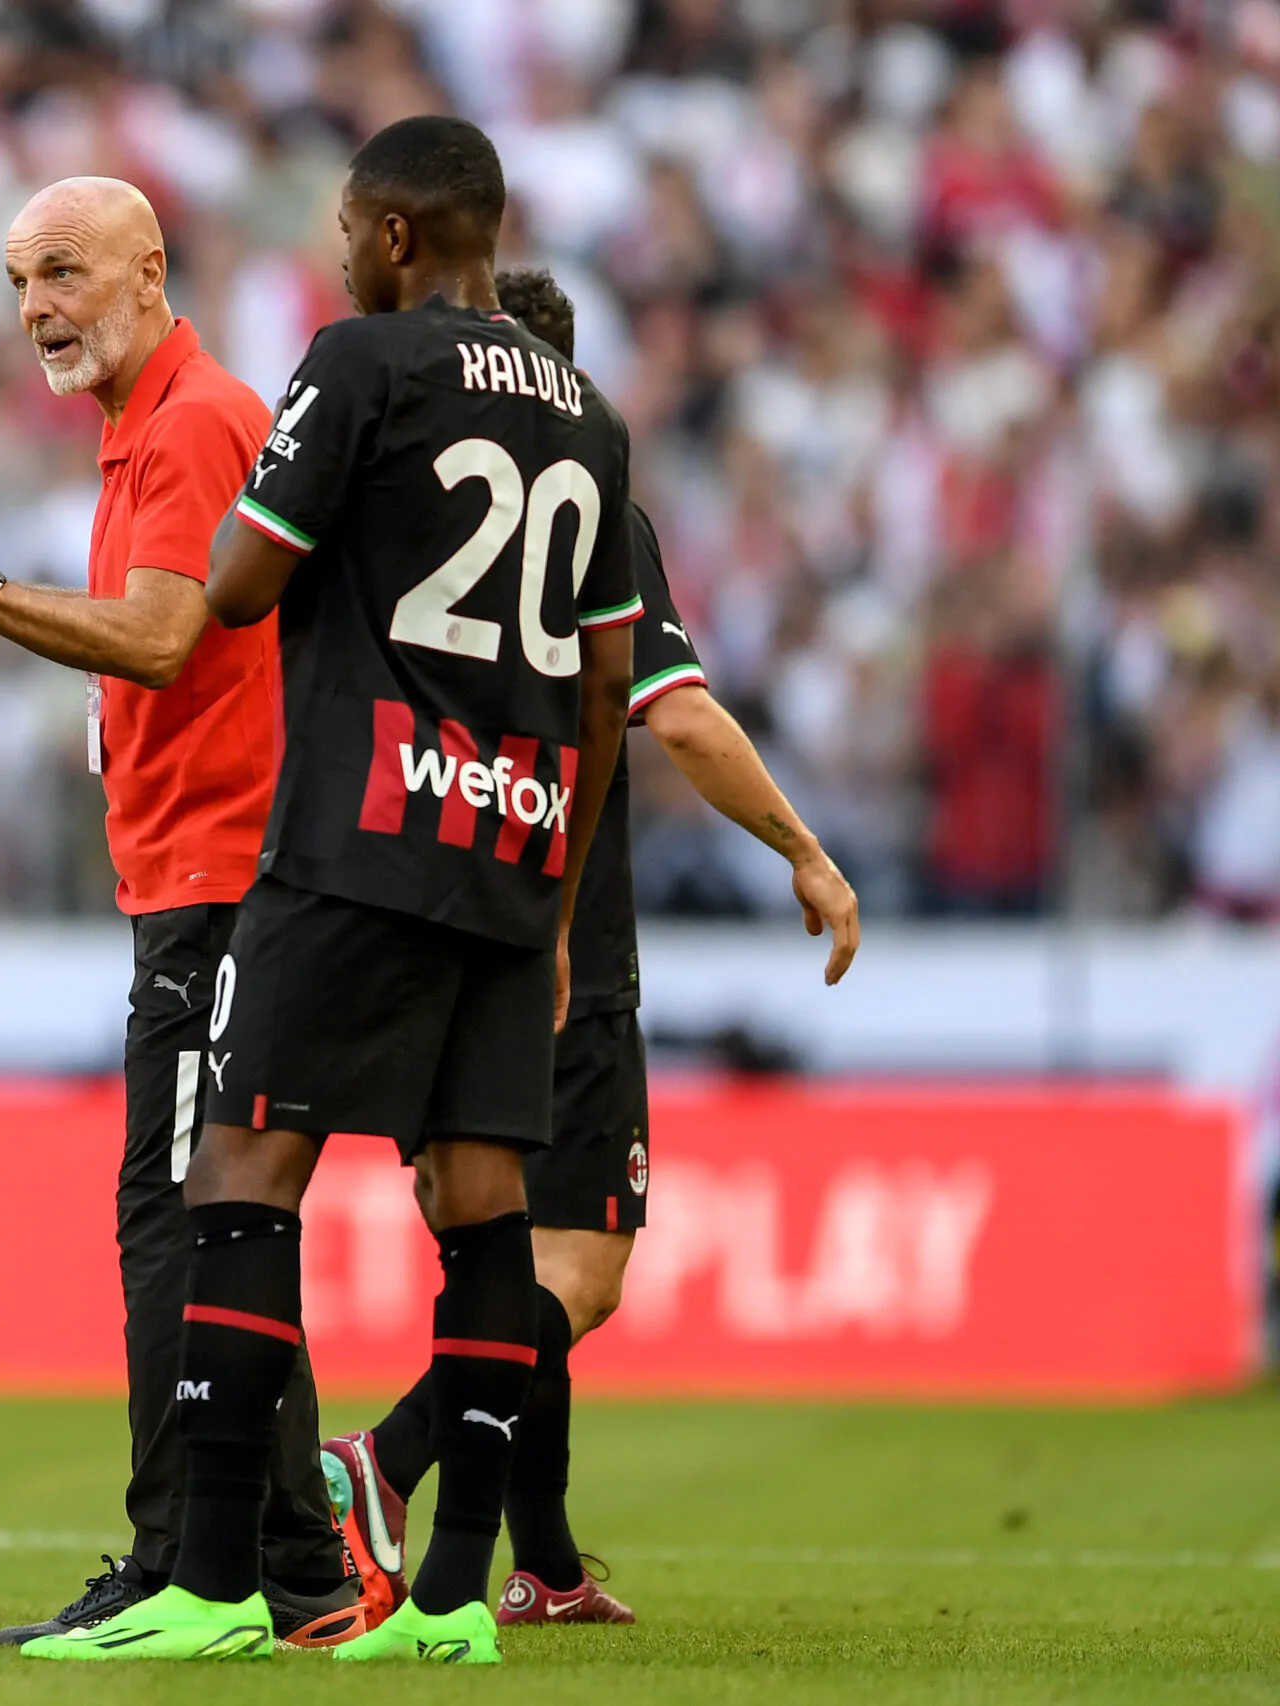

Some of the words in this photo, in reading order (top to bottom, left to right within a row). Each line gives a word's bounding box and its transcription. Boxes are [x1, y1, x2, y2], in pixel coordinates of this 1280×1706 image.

[456, 343, 583, 417] KALULU
[389, 438, 601, 677] 20
[398, 742, 570, 834] wefox
